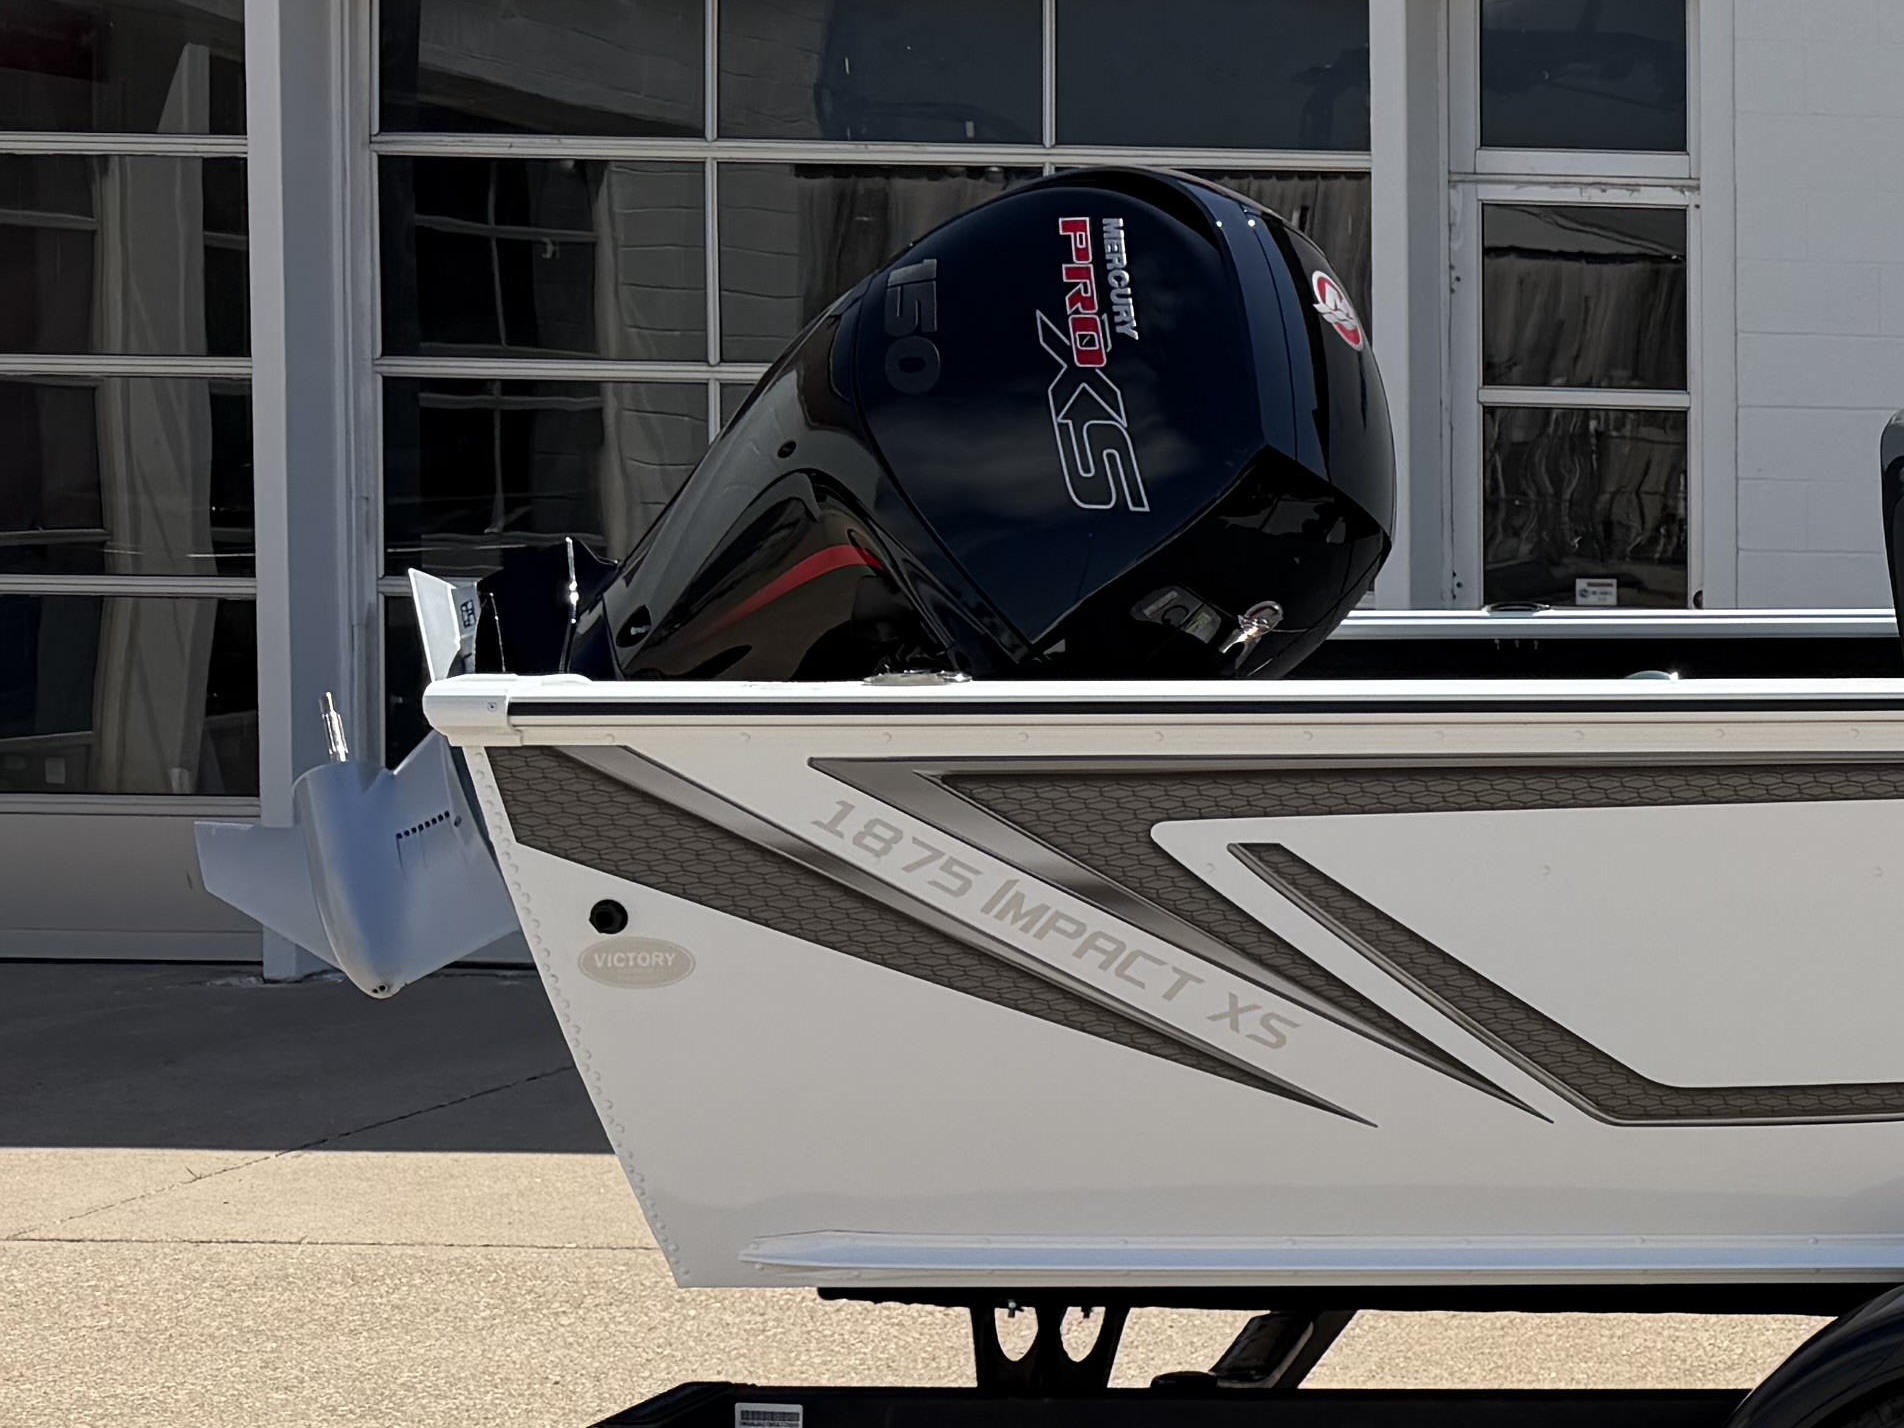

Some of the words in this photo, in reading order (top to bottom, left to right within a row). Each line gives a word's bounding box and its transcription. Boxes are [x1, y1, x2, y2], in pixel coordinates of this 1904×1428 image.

[884, 258, 941, 395] 150
[1058, 216, 1108, 368] PRO
[1102, 217, 1139, 341] MERCURY
[1035, 308, 1151, 512] XS
[593, 951, 676, 969] VICTORY
[810, 799, 984, 899] 1875
[979, 878, 1205, 1002] IMPACT
[1206, 991, 1302, 1051] XS
